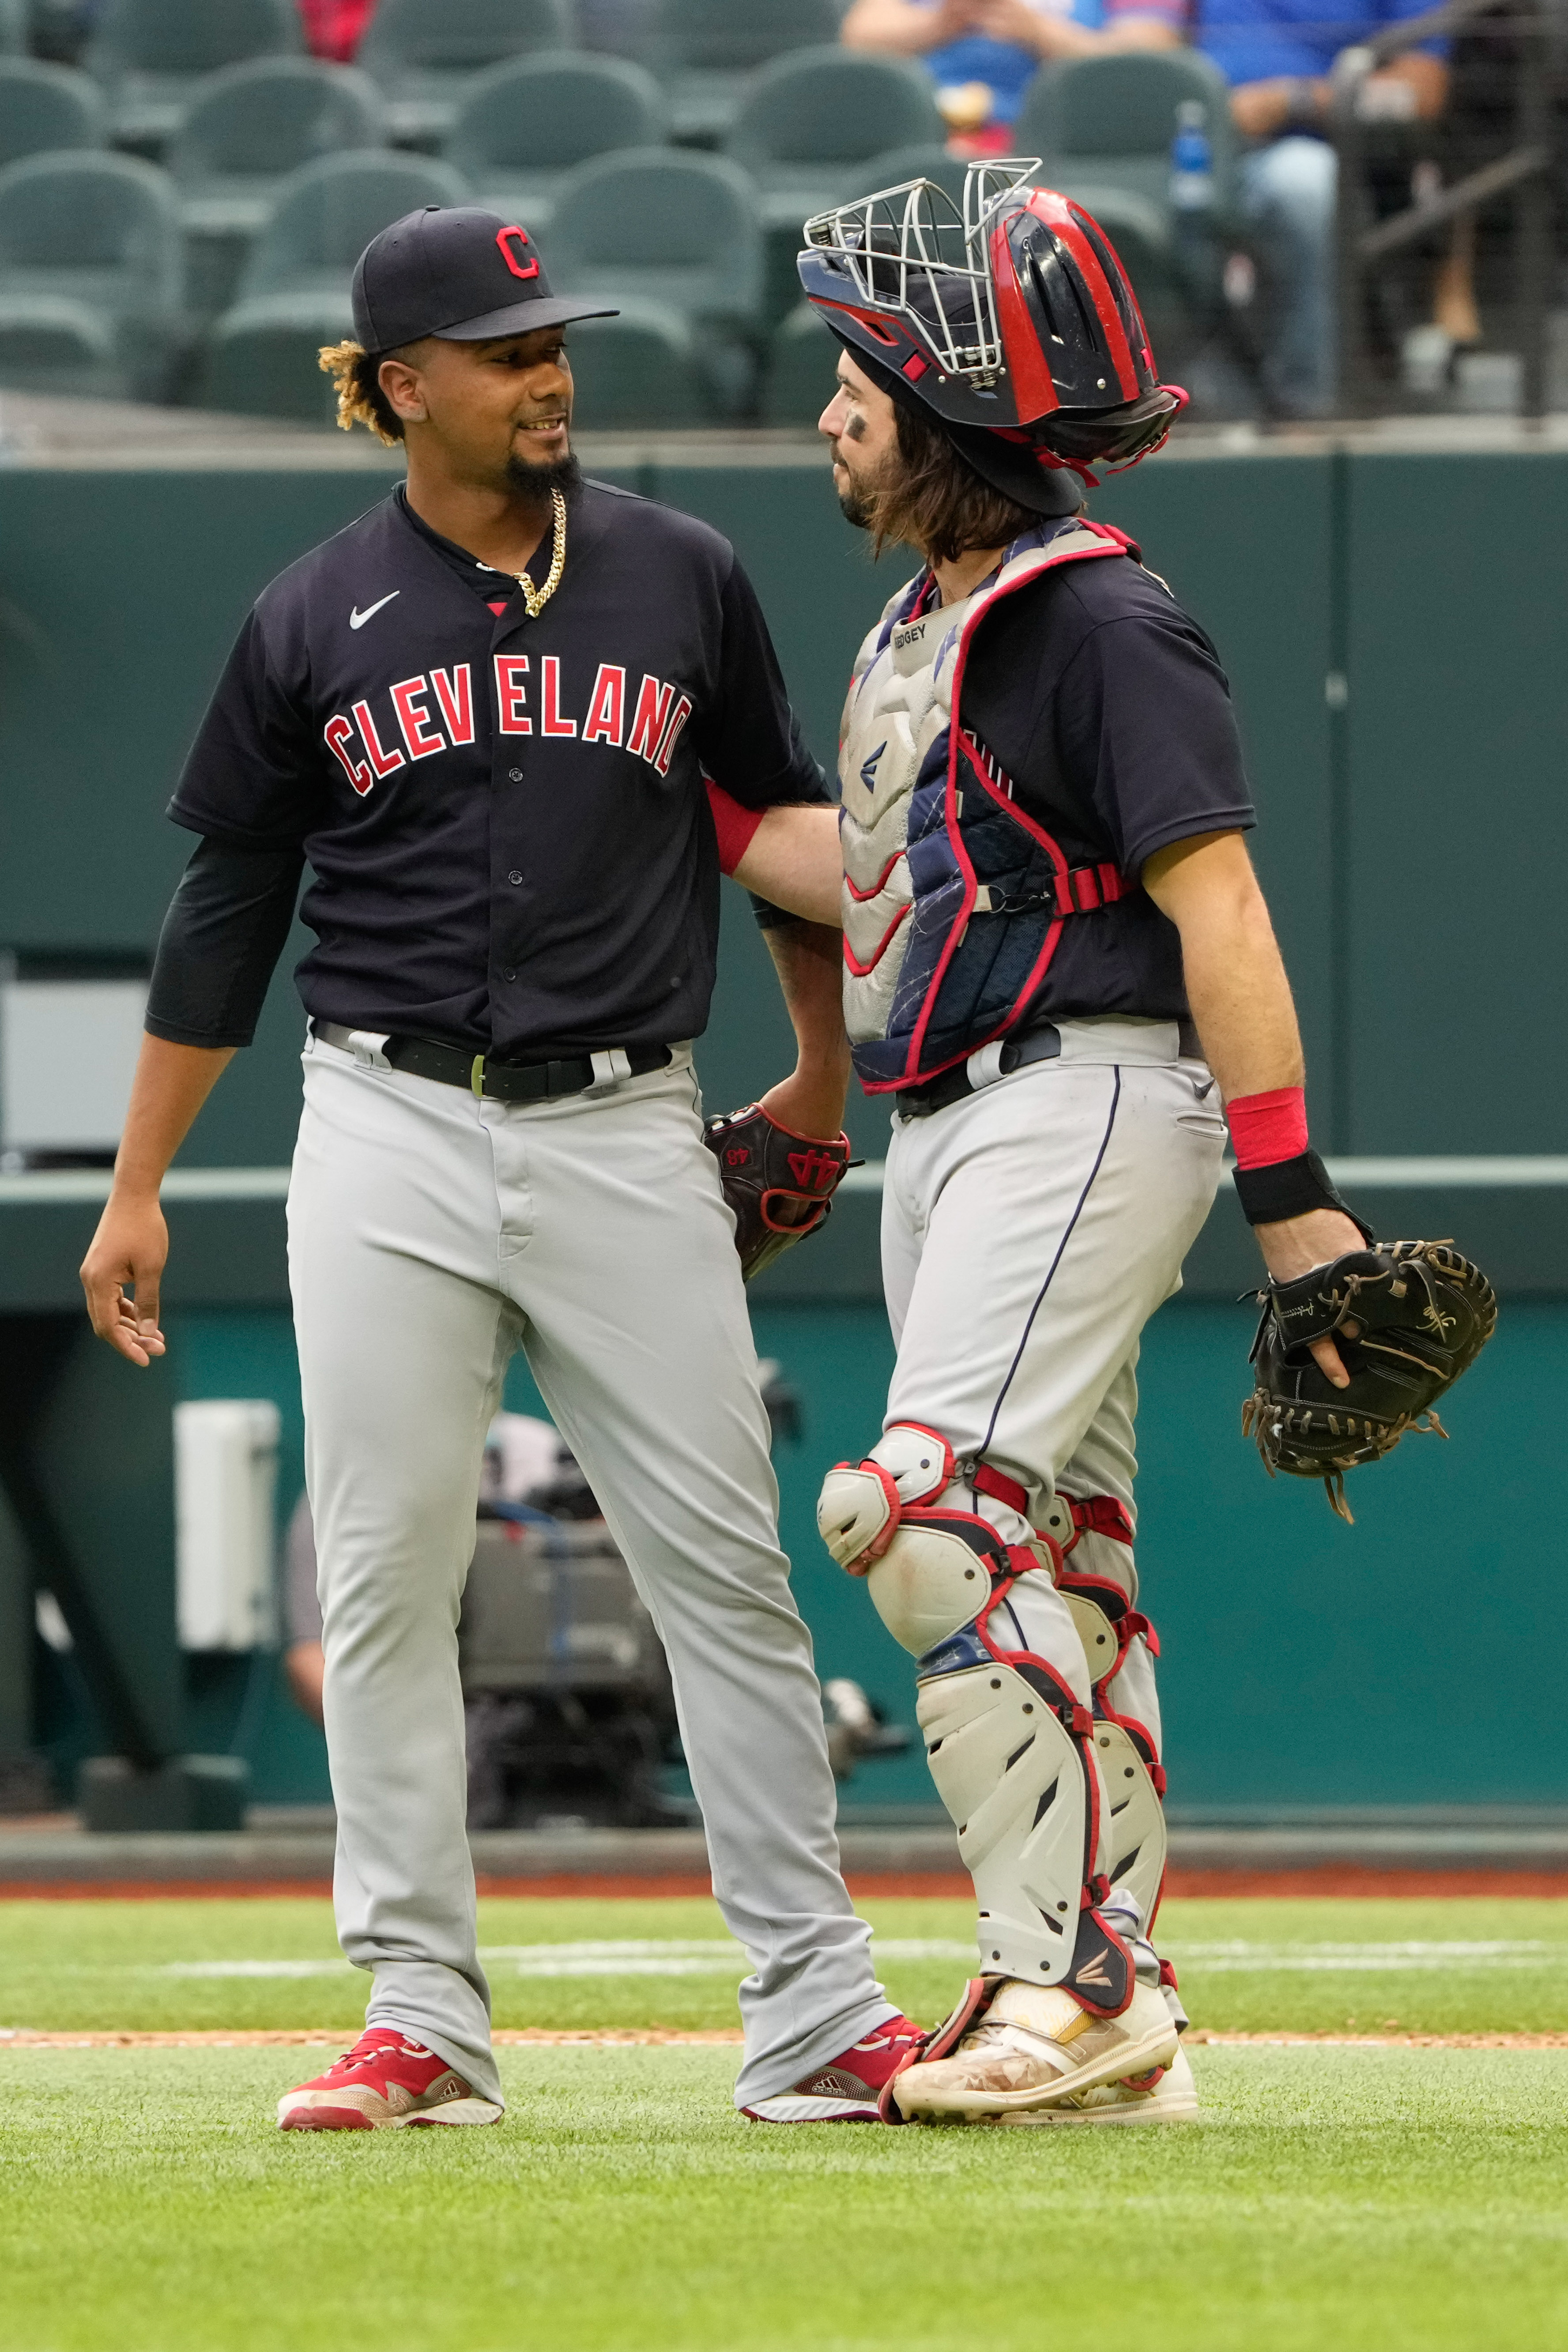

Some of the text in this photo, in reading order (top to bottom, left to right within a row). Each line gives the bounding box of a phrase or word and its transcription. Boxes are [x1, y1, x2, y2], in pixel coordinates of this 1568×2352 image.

[496, 226, 539, 280] C
[324, 655, 692, 797] CLEVELAND
[788, 1150, 839, 1190] 44
[813, 2087, 845, 2096] adidas
